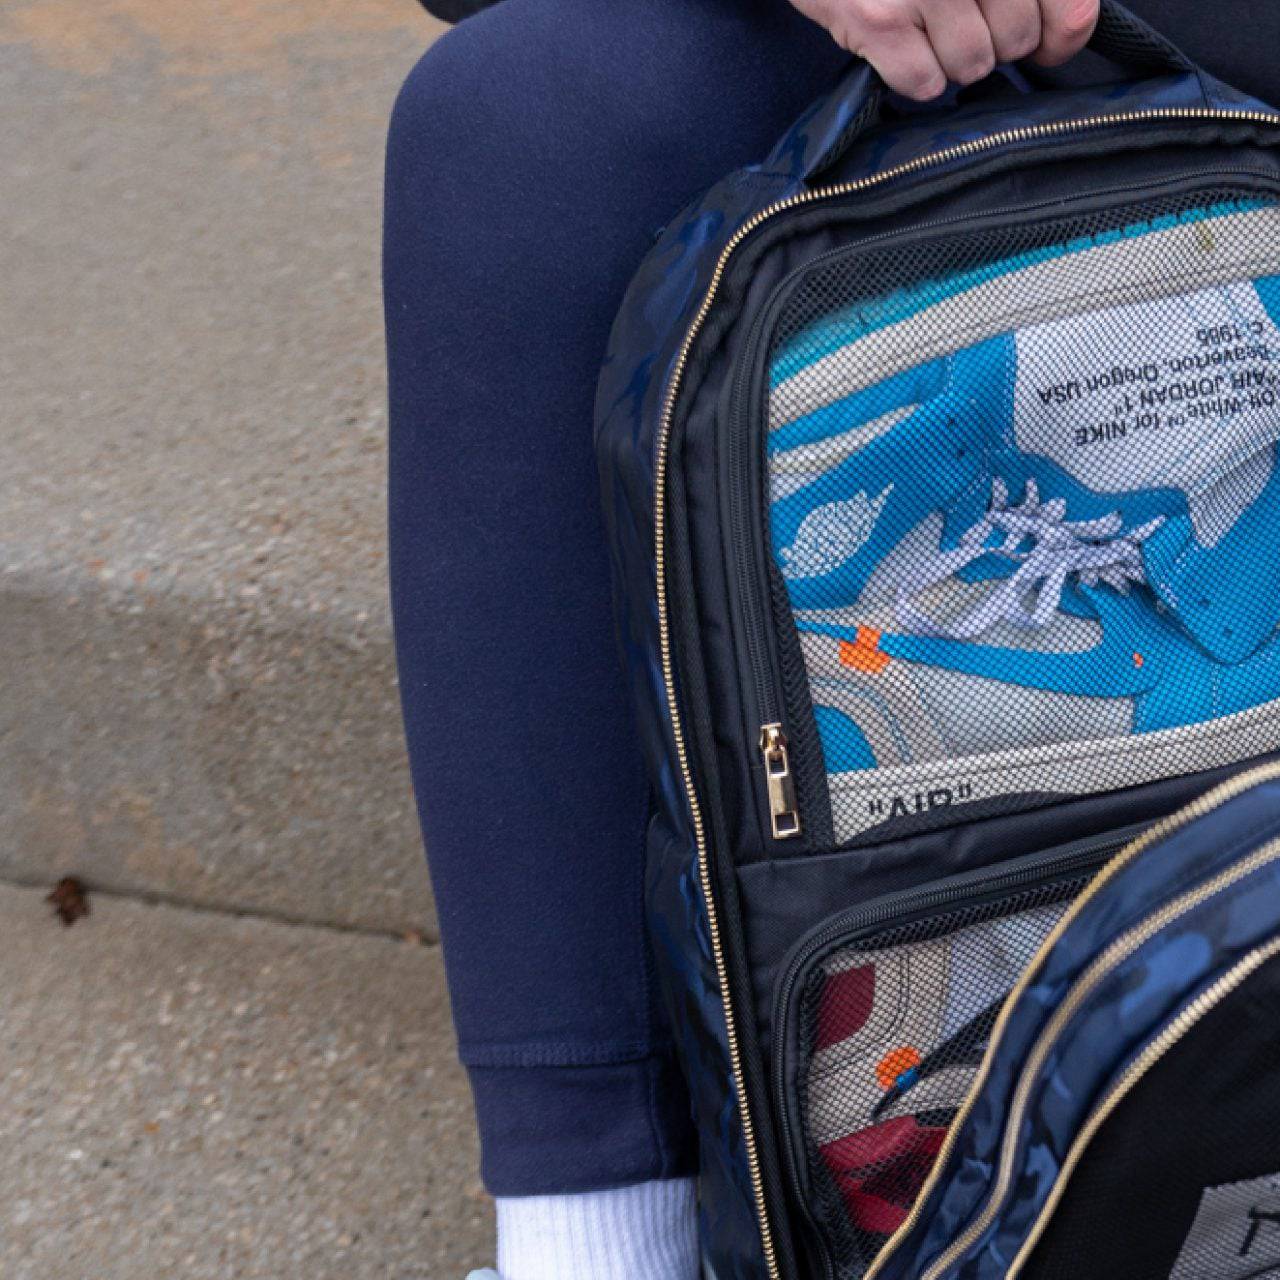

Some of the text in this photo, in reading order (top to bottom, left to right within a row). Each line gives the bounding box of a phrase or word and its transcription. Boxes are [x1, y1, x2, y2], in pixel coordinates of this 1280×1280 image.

[1196, 324, 1242, 345] 1985
[1036, 344, 1269, 406] Beaverton, Oregon USA
[1140, 374, 1223, 404] JORDAN
[1073, 419, 1128, 447] NIKE
[1132, 411, 1160, 432] for
